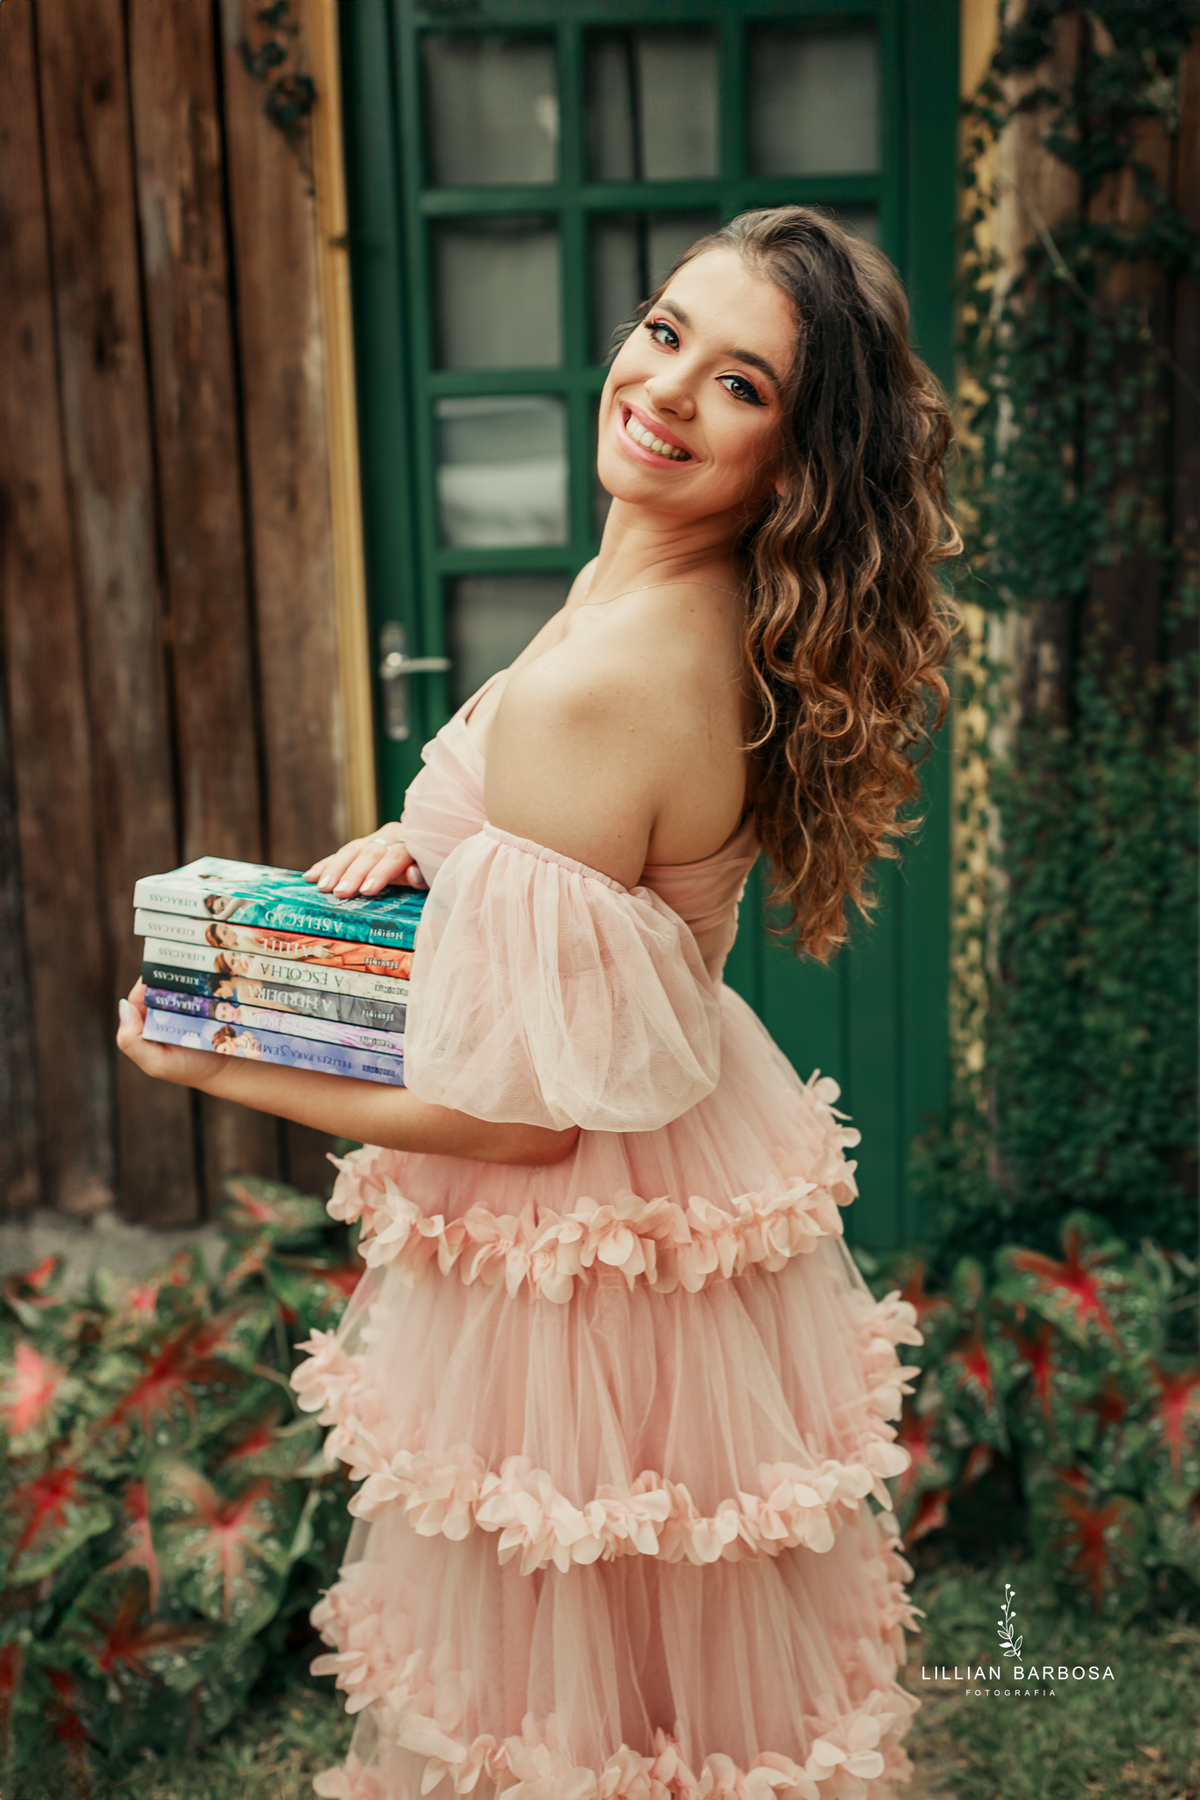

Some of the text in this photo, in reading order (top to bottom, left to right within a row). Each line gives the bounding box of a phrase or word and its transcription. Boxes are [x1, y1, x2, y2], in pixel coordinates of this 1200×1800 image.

[149, 893, 198, 907] KIERA CASS
[148, 922, 195, 936] KIERA CASS
[333, 921, 344, 933] A
[158, 947, 206, 962] KIERA CASS
[260, 938, 312, 957] A ELITE
[152, 970, 199, 986] KIERA CASS
[260, 963, 344, 987] A ESCOLHA
[155, 996, 201, 1012] KIERA CASS
[248, 984, 332, 1012] A HERDEIRA
[155, 1024, 176, 1034] CASS
[243, 1040, 352, 1069] FELIZES PARA SEMPRE
